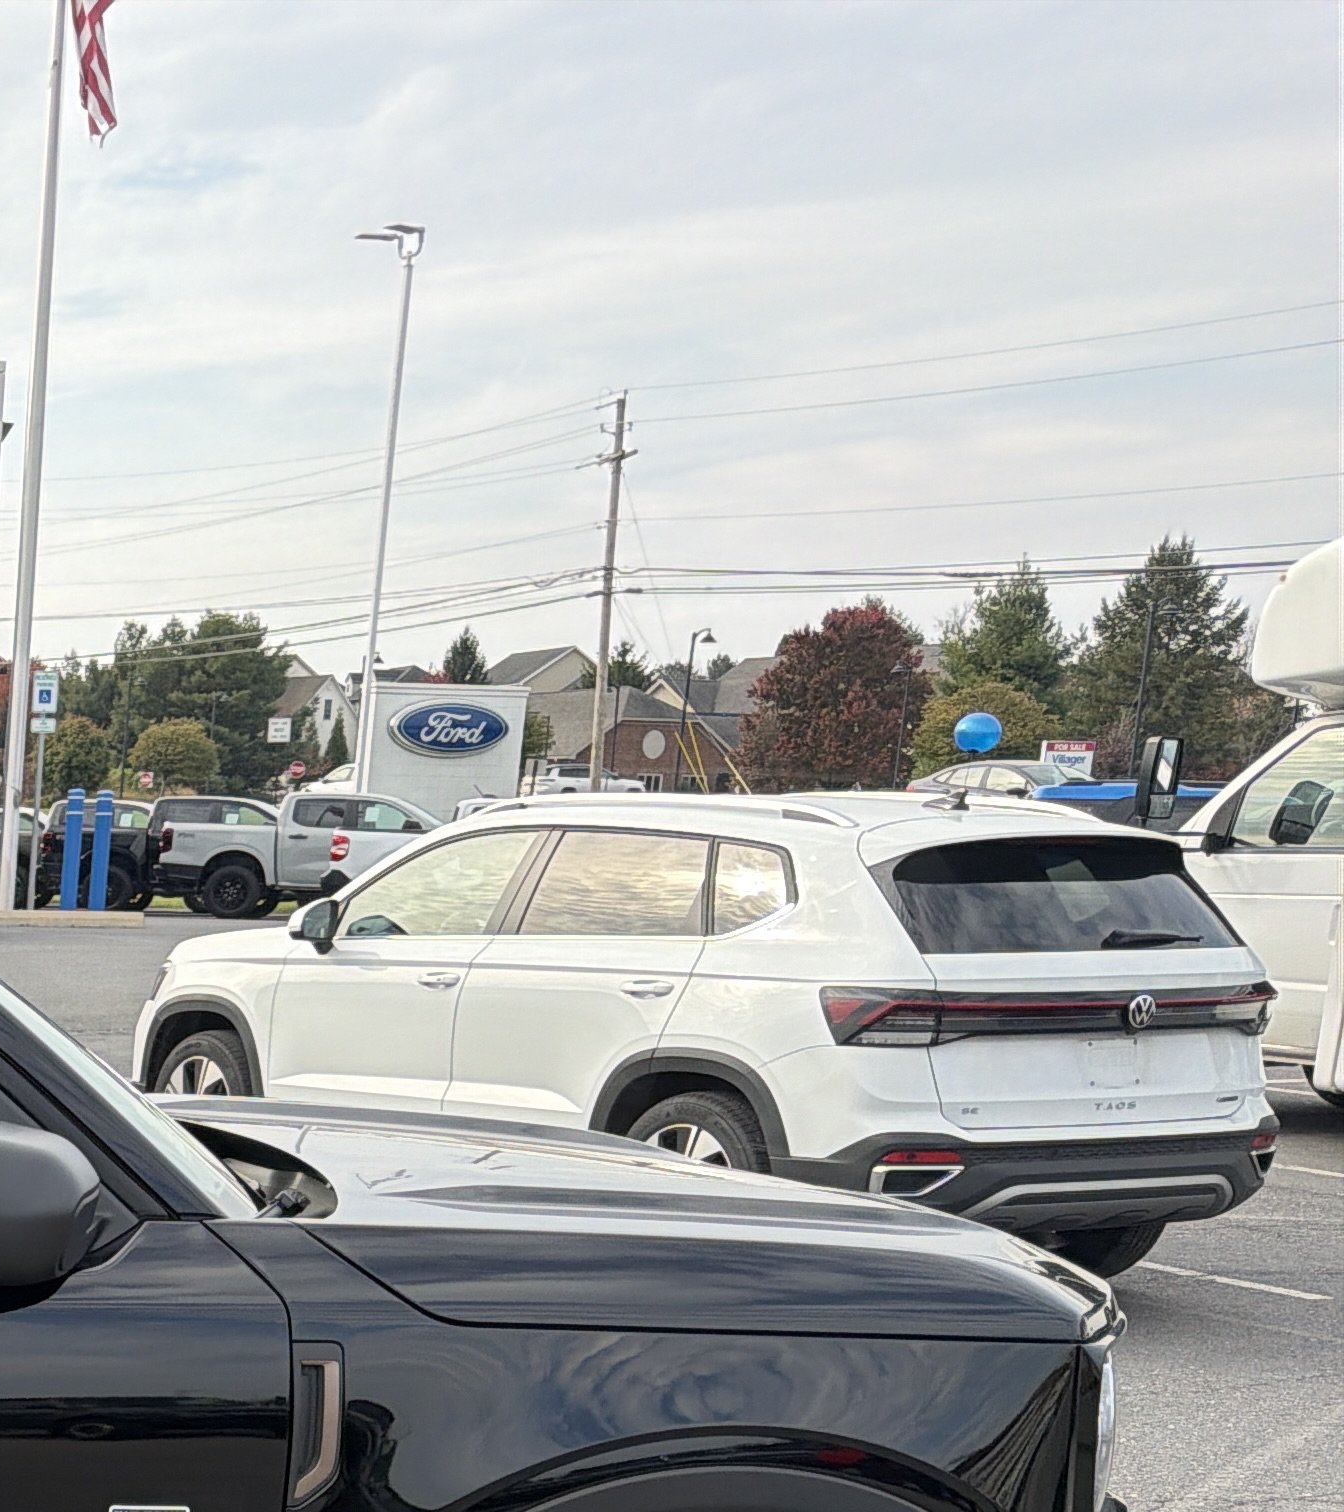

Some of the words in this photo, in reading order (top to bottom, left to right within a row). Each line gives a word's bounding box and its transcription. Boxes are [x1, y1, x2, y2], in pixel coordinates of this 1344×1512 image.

[420, 711, 487, 744] Ford
[1054, 743, 1069, 751] FOR
[1069, 743, 1087, 751] SALE
[1052, 754, 1087, 767] Villager
[961, 1107, 980, 1115] SE
[1094, 1100, 1137, 1111] TAOS
